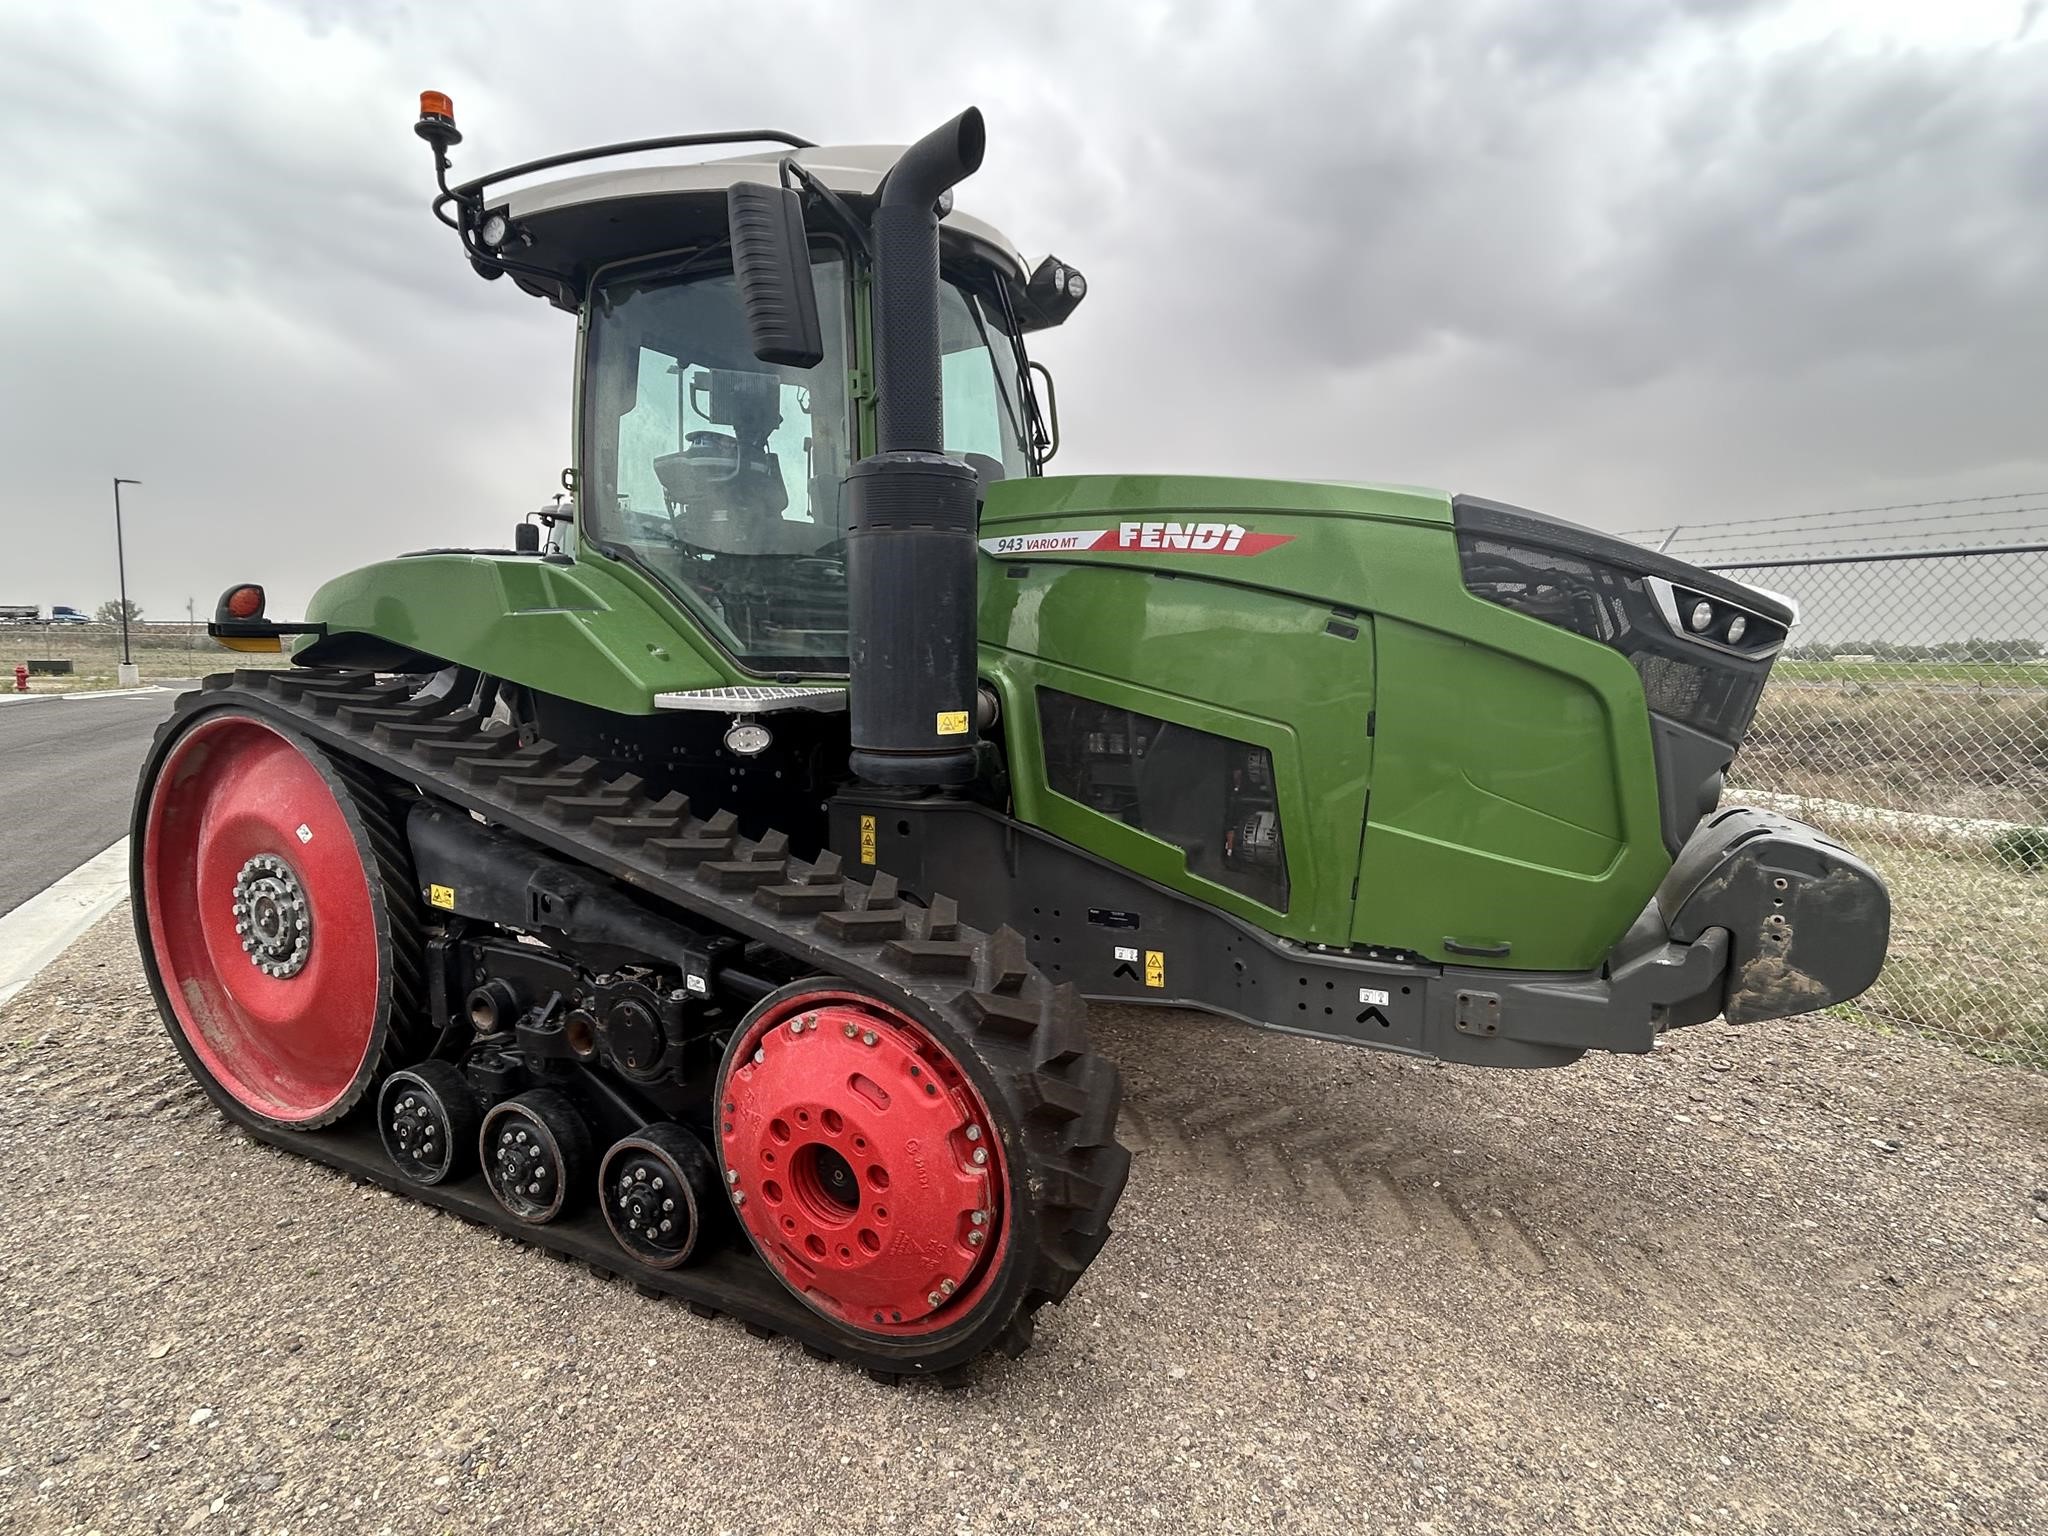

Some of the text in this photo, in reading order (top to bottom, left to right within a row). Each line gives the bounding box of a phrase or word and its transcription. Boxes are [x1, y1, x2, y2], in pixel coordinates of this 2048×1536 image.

[997, 537, 1078, 552] 943 VARIO MT
[1119, 522, 1246, 551] FENDT
